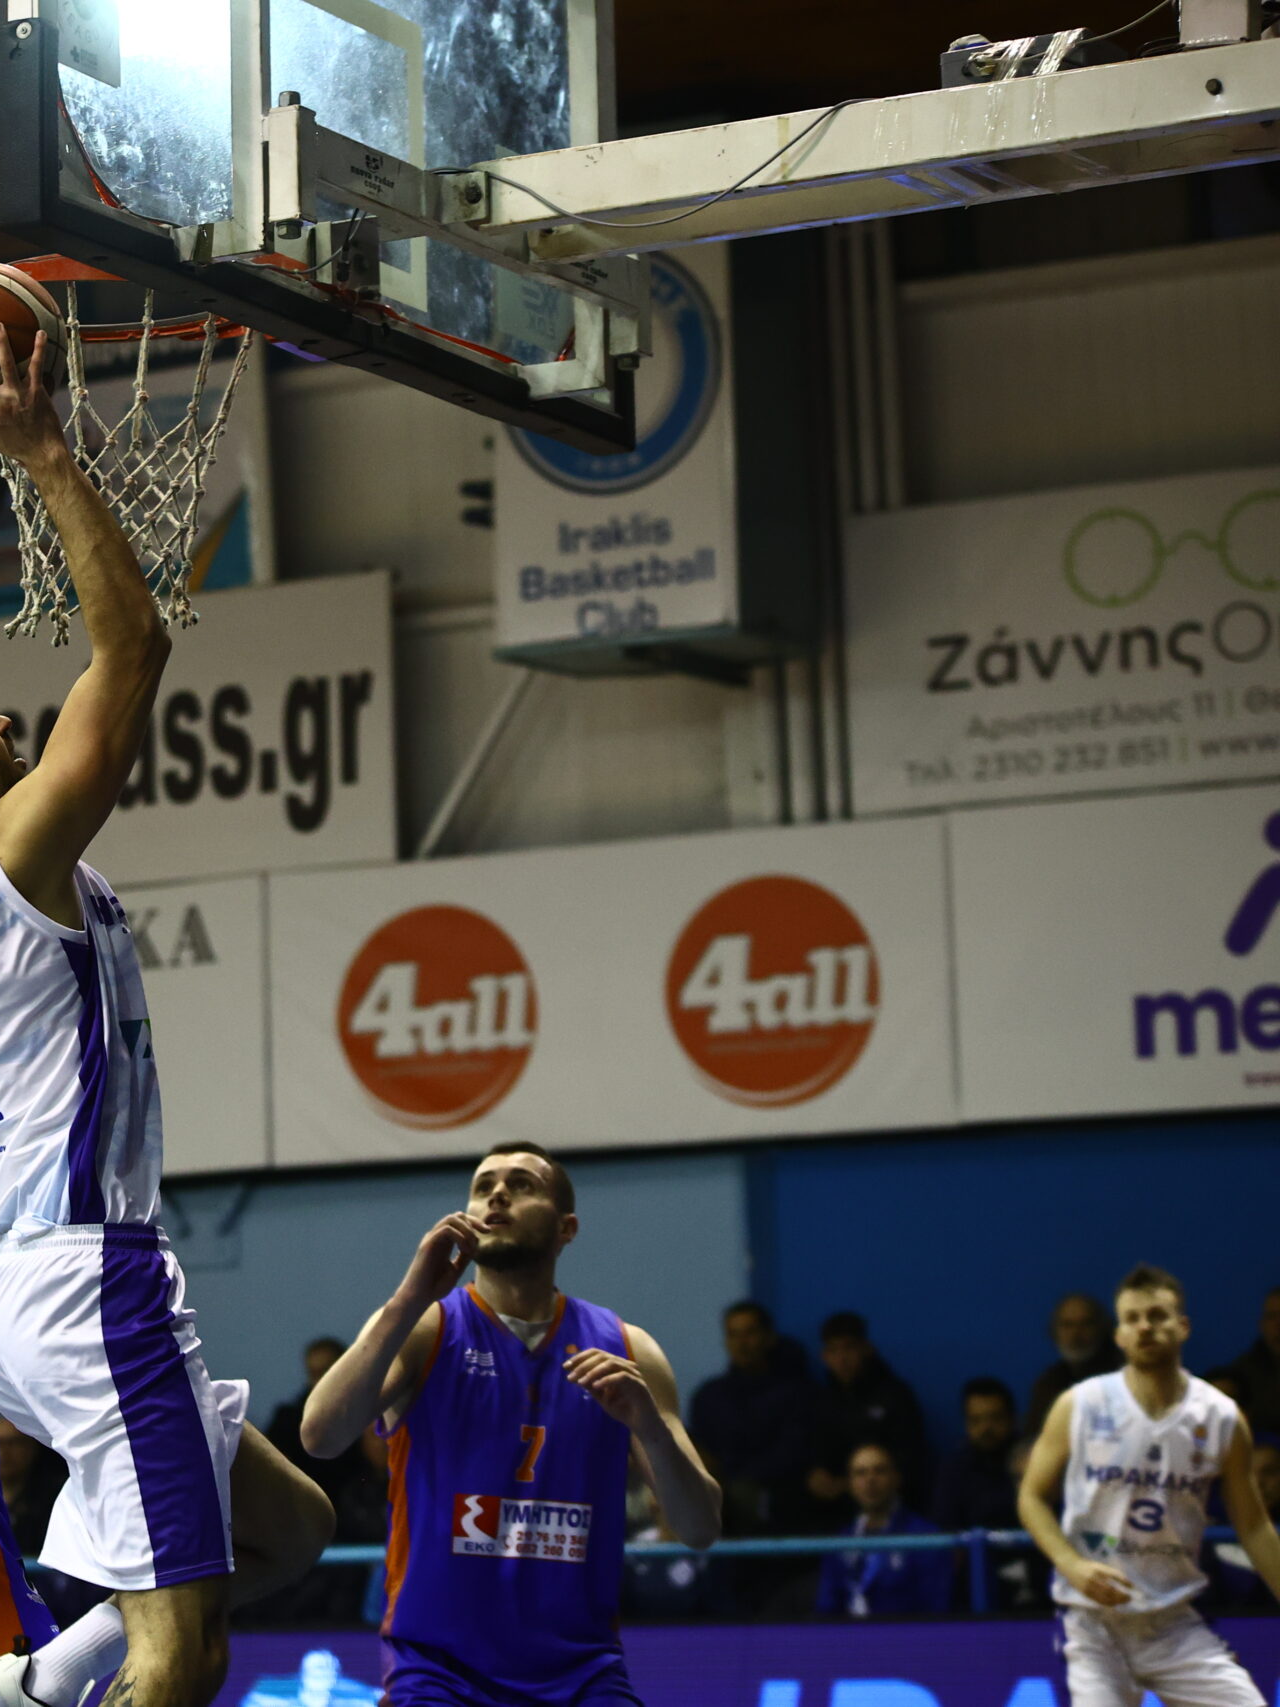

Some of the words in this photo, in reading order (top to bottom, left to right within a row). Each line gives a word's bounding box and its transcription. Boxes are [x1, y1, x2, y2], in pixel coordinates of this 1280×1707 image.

[558, 513, 672, 553] Iraklis
[519, 549, 716, 601] Basketball
[576, 598, 659, 638] Club
[926, 625, 1204, 694] Ζάννης
[683, 933, 875, 1036] 4all
[349, 960, 535, 1060] 4all
[515, 1424, 546, 1482] 7
[502, 1503, 592, 1528] ΥΜΗΤΤΟΣ
[1128, 1499, 1164, 1533] 3
[464, 1540, 496, 1553] EKO
